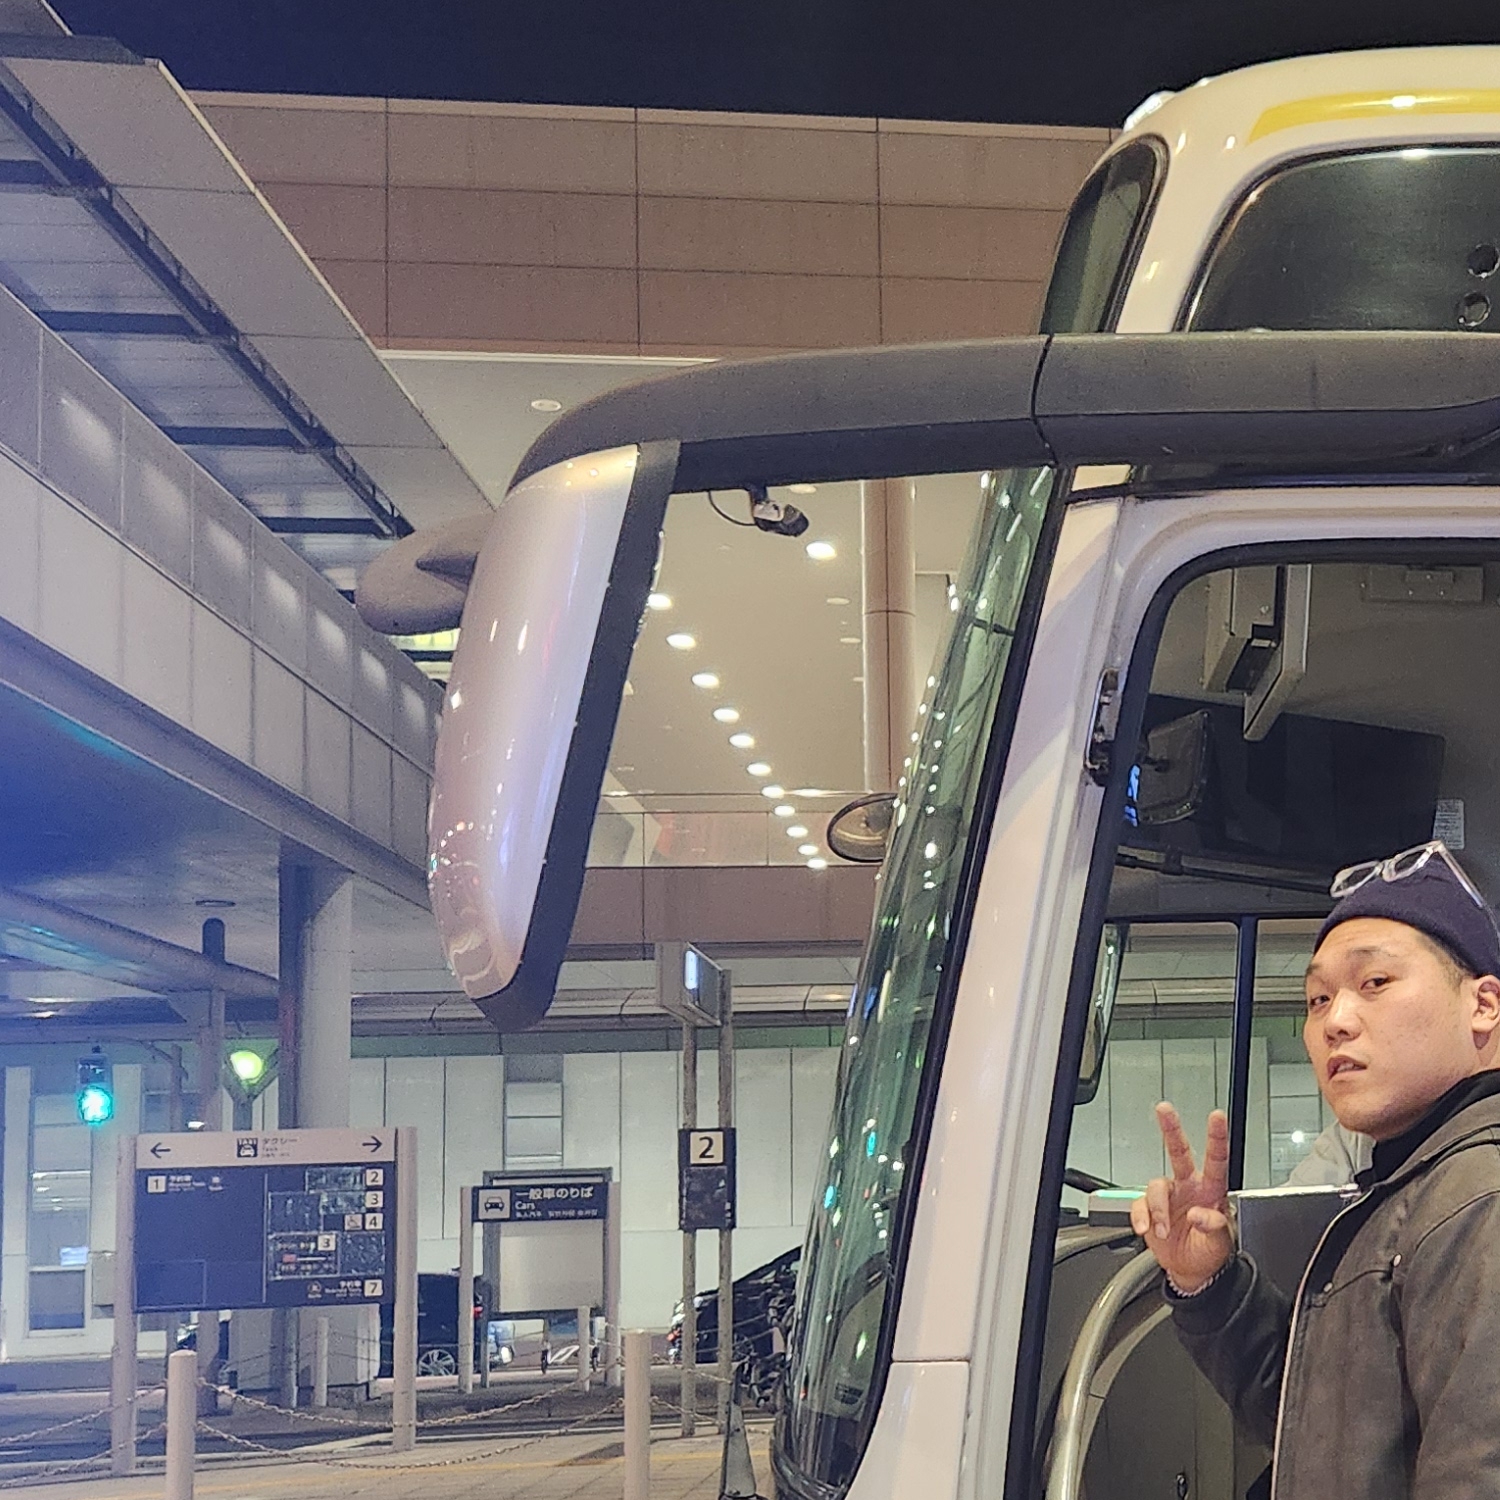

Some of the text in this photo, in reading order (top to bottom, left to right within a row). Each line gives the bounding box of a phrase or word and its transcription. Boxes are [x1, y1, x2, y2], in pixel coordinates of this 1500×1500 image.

[262, 1137, 297, 1146] タクシー
[699, 1136, 715, 1159] 2
[516, 1187, 594, 1200] 一般車のりば
[515, 1201, 535, 1210] Cars
